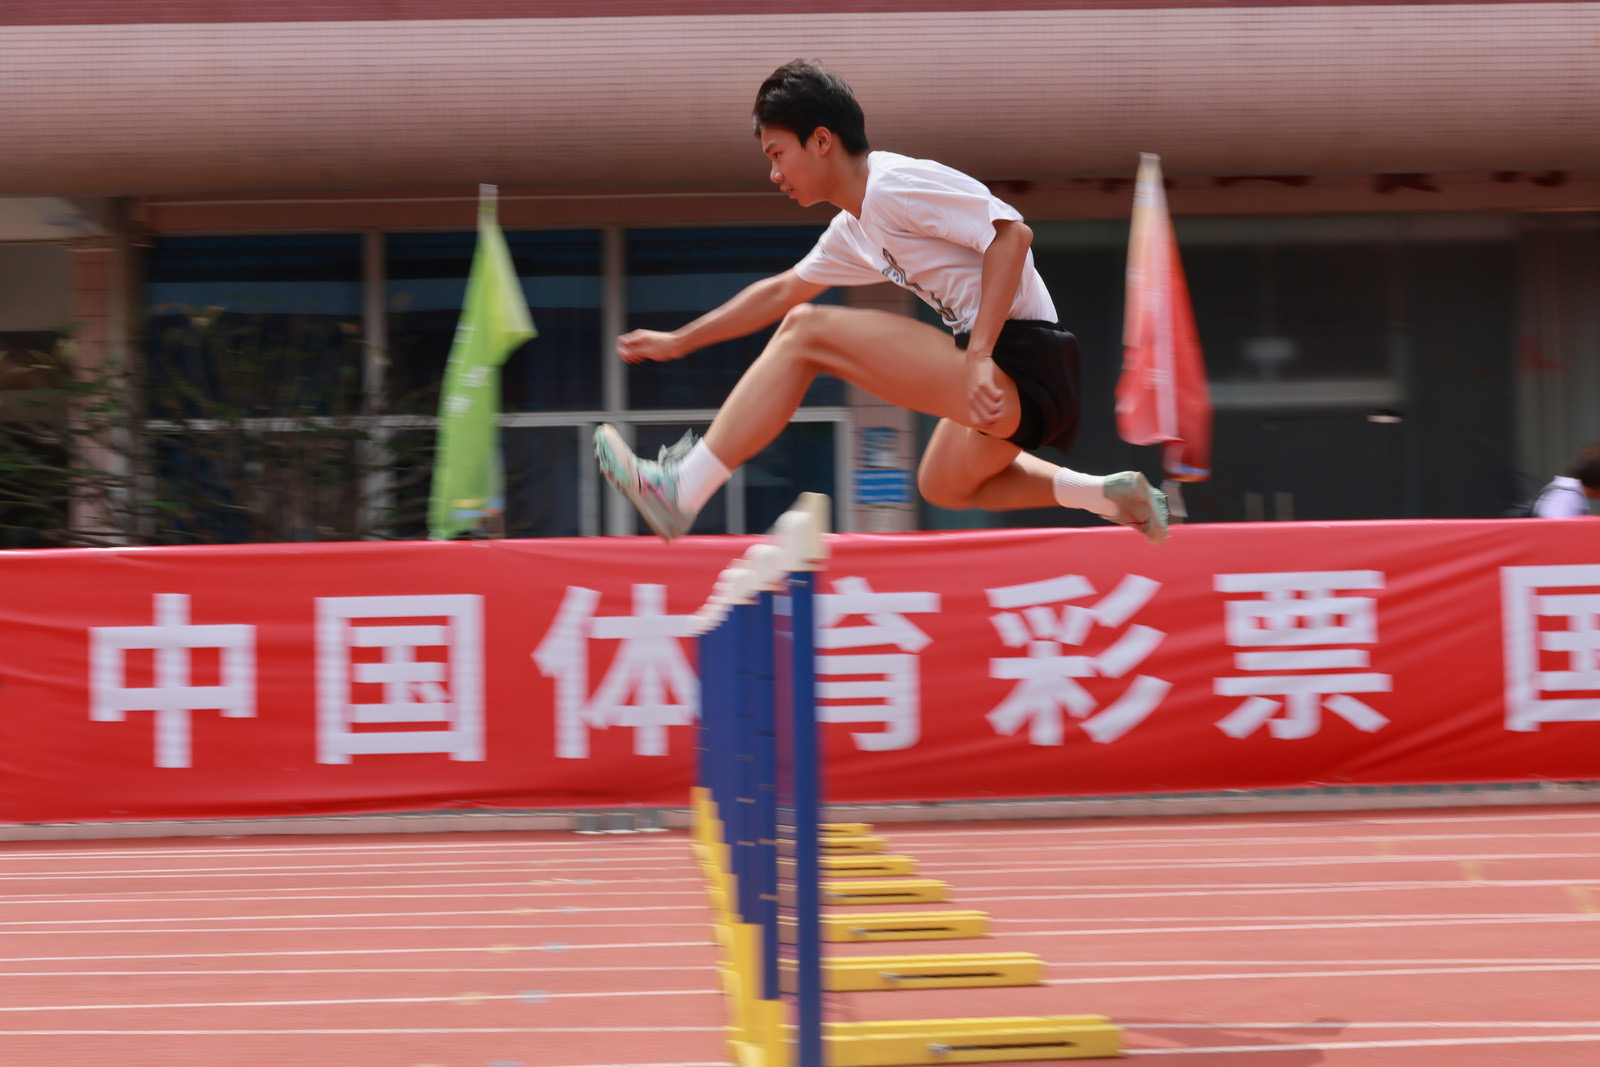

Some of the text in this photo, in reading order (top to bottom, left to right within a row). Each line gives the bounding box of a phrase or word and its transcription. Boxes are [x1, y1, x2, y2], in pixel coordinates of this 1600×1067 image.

[89, 570, 1392, 769] 中国体育彩票
